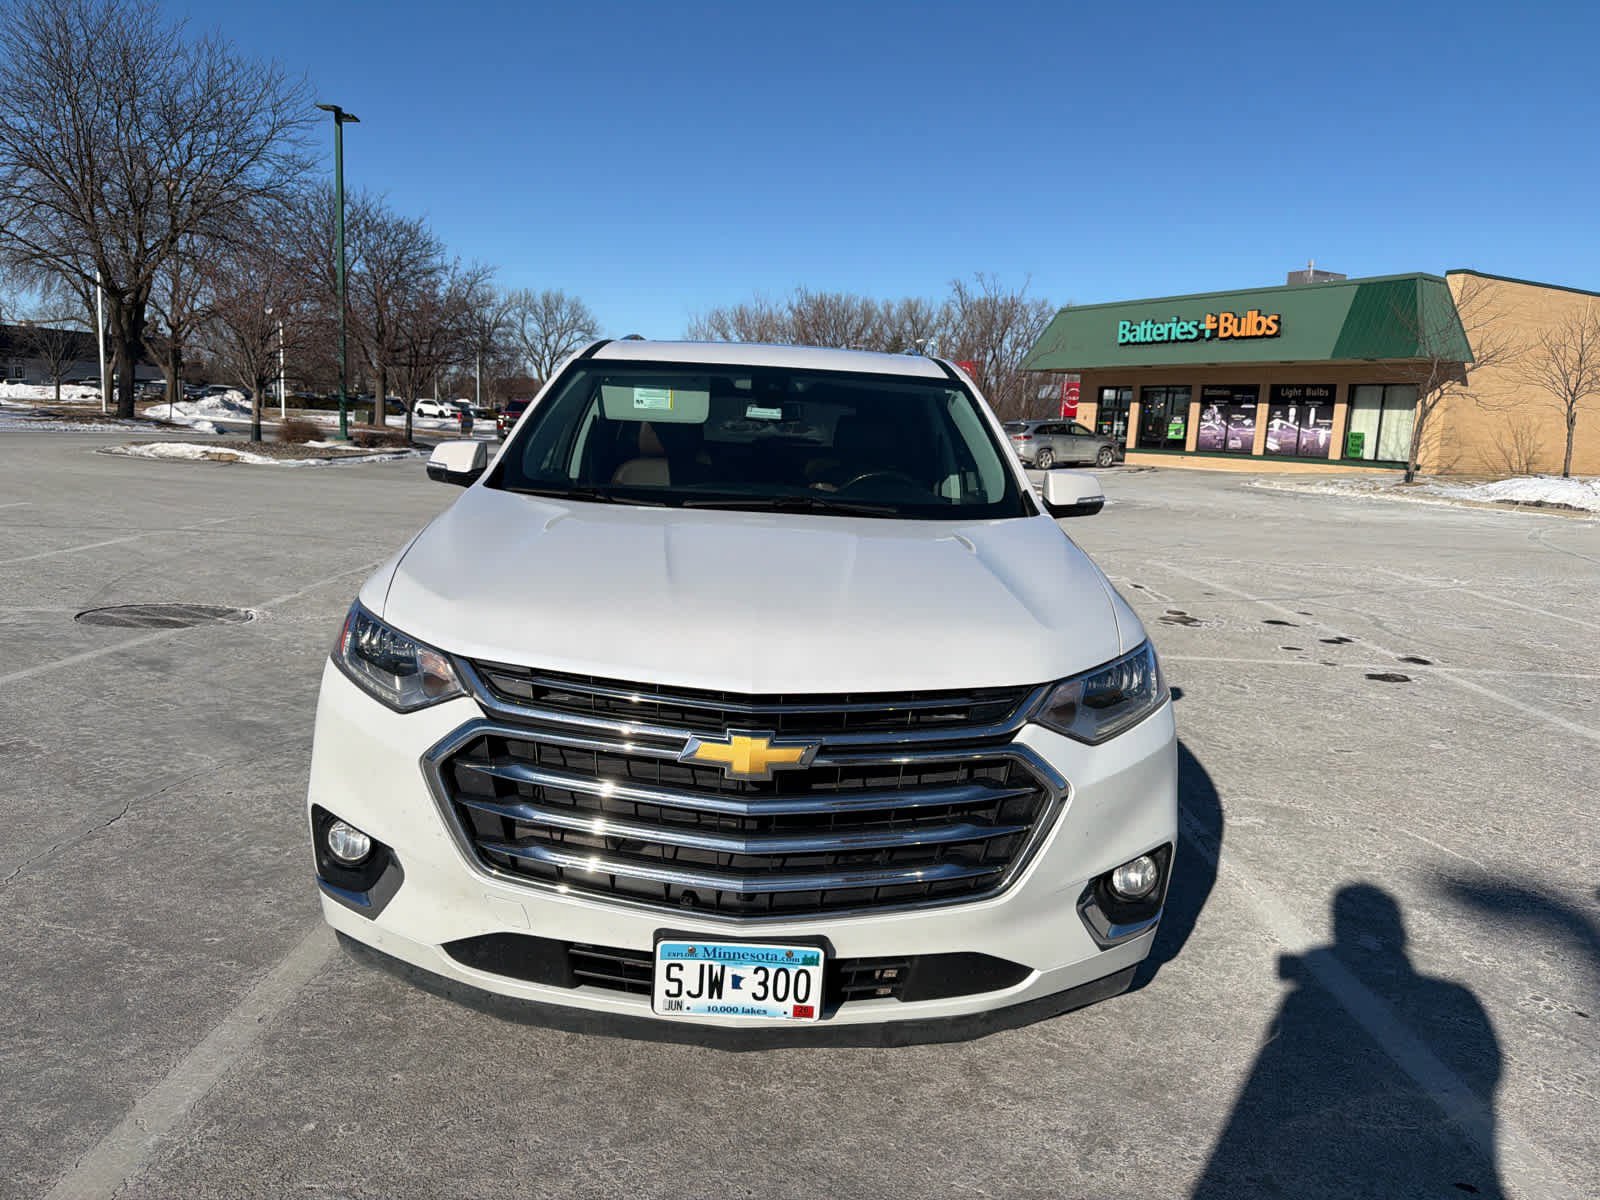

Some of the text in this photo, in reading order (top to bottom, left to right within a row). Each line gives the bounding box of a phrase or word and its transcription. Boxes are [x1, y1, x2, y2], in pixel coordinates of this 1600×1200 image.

[1281, 388, 1329, 398] Light Bulbs
[664, 962, 811, 1003] SJW 300
[665, 1000, 683, 1012] JUN
[706, 1005, 739, 1014] 10,000
[741, 1005, 768, 1016] lakes
